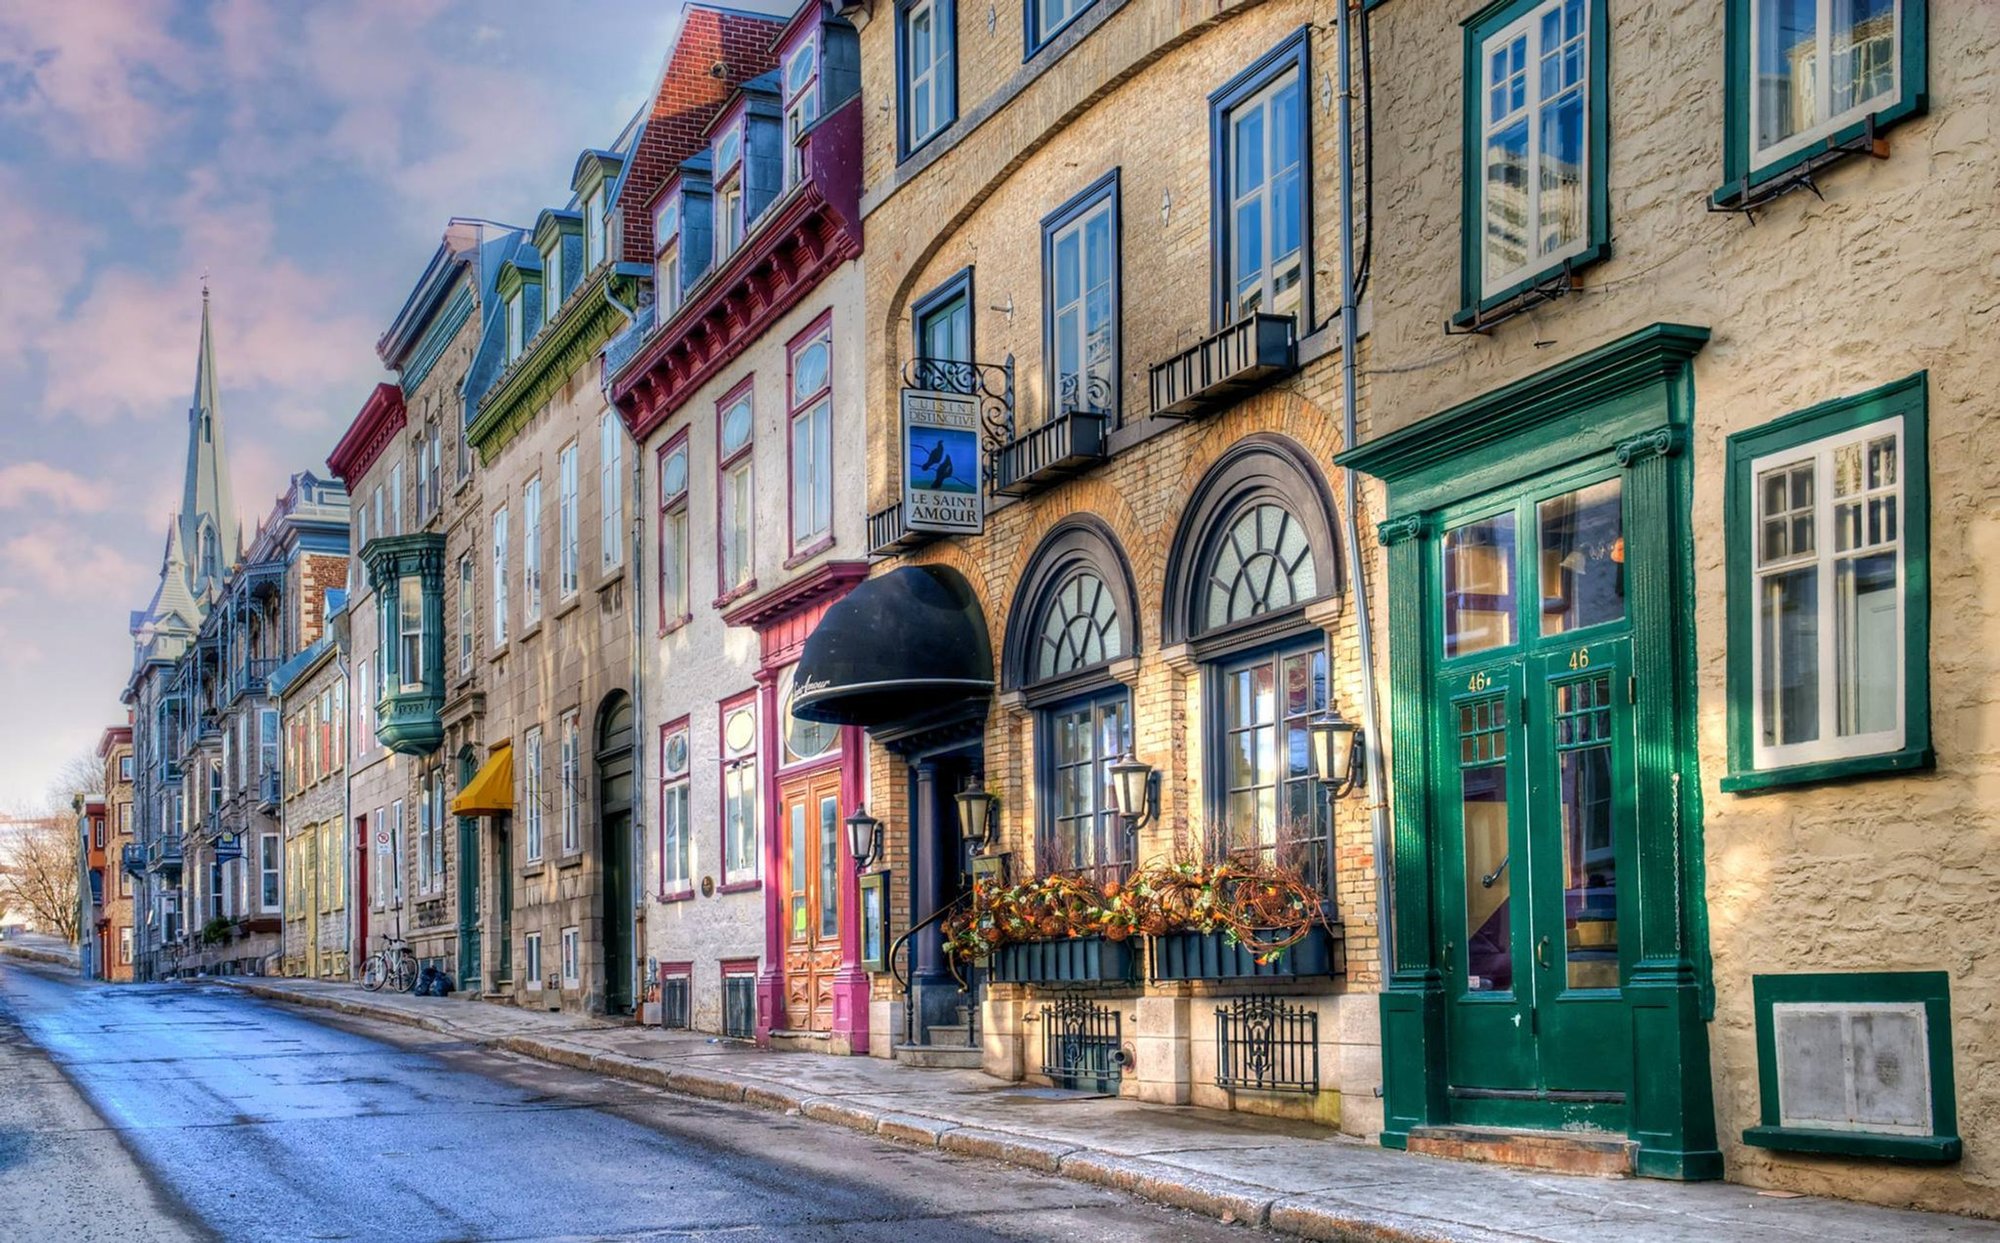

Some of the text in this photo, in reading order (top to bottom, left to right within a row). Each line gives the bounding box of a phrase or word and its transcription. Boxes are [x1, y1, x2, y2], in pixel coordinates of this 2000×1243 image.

[908, 399, 976, 414] CUISINE
[909, 411, 977, 426] DISTINCTIVE
[911, 493, 977, 508] LE SAINT
[911, 506, 978, 523] AMOUR
[1569, 647, 1590, 670] 46
